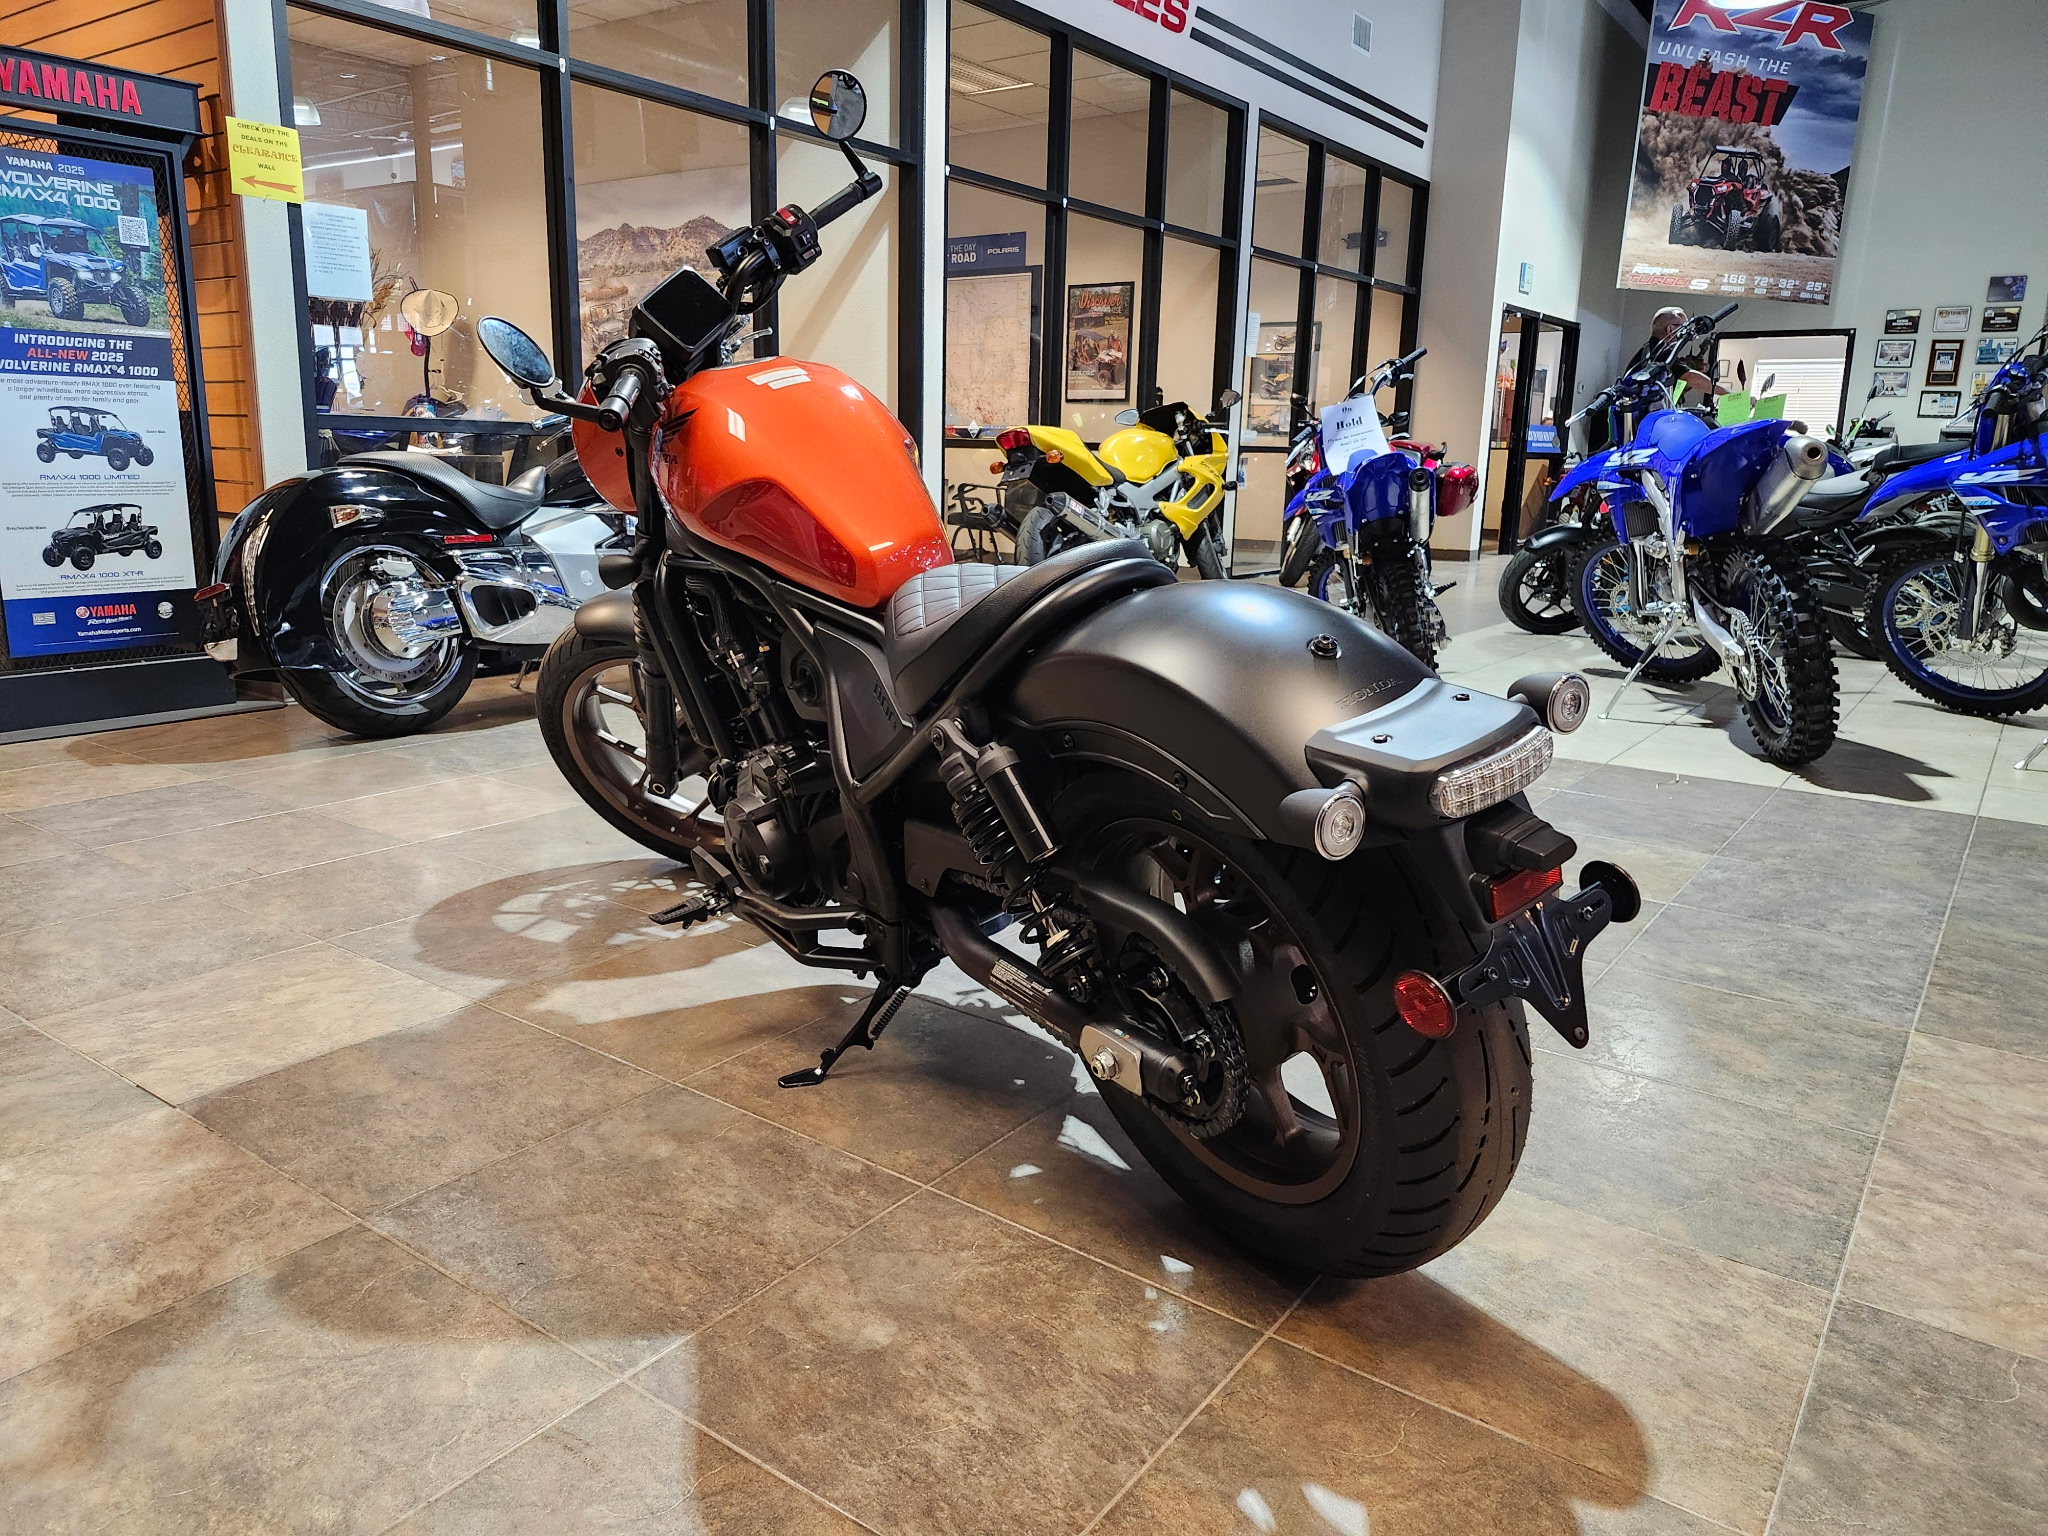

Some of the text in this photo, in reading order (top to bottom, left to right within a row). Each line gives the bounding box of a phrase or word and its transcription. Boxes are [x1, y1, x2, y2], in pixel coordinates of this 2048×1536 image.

[1657, 41, 1792, 75] UNLEASH THE
[0, 57, 142, 115] YAMAHA
[1649, 61, 1789, 127] BEAST
[237, 122, 260, 132] CHECK
[276, 129, 290, 137] THE
[241, 134, 263, 143] DEALS
[232, 143, 299, 163] CLEARANCE
[6, 155, 85, 176] YAMAHA 2025
[257, 162, 277, 171] WALL
[0, 184, 121, 211] MAX4 1000
[950, 243, 977, 253] THE DAY
[987, 246, 1020, 255] POLARIS
[951, 252, 977, 264] ROAD
[1628, 273, 1711, 291] TURBO S
[1722, 273, 1746, 285] 168
[1078, 288, 1122, 309] Discover
[14, 333, 134, 350] INTRODUCING THE
[26, 347, 124, 363] ALL-NEW 2025
[128, 366, 160, 377] 1000
[24, 378, 80, 388] adventure-ready
[81, 380, 100, 388] RMAX
[133, 383, 161, 391] featuring
[33, 394, 54, 402] plenty
[1336, 416, 1363, 430] Hold
[90, 603, 137, 617] YAMAHA
[77, 626, 142, 637] YamahaMotorsports.com
[1335, 678, 1404, 710] HONDA
